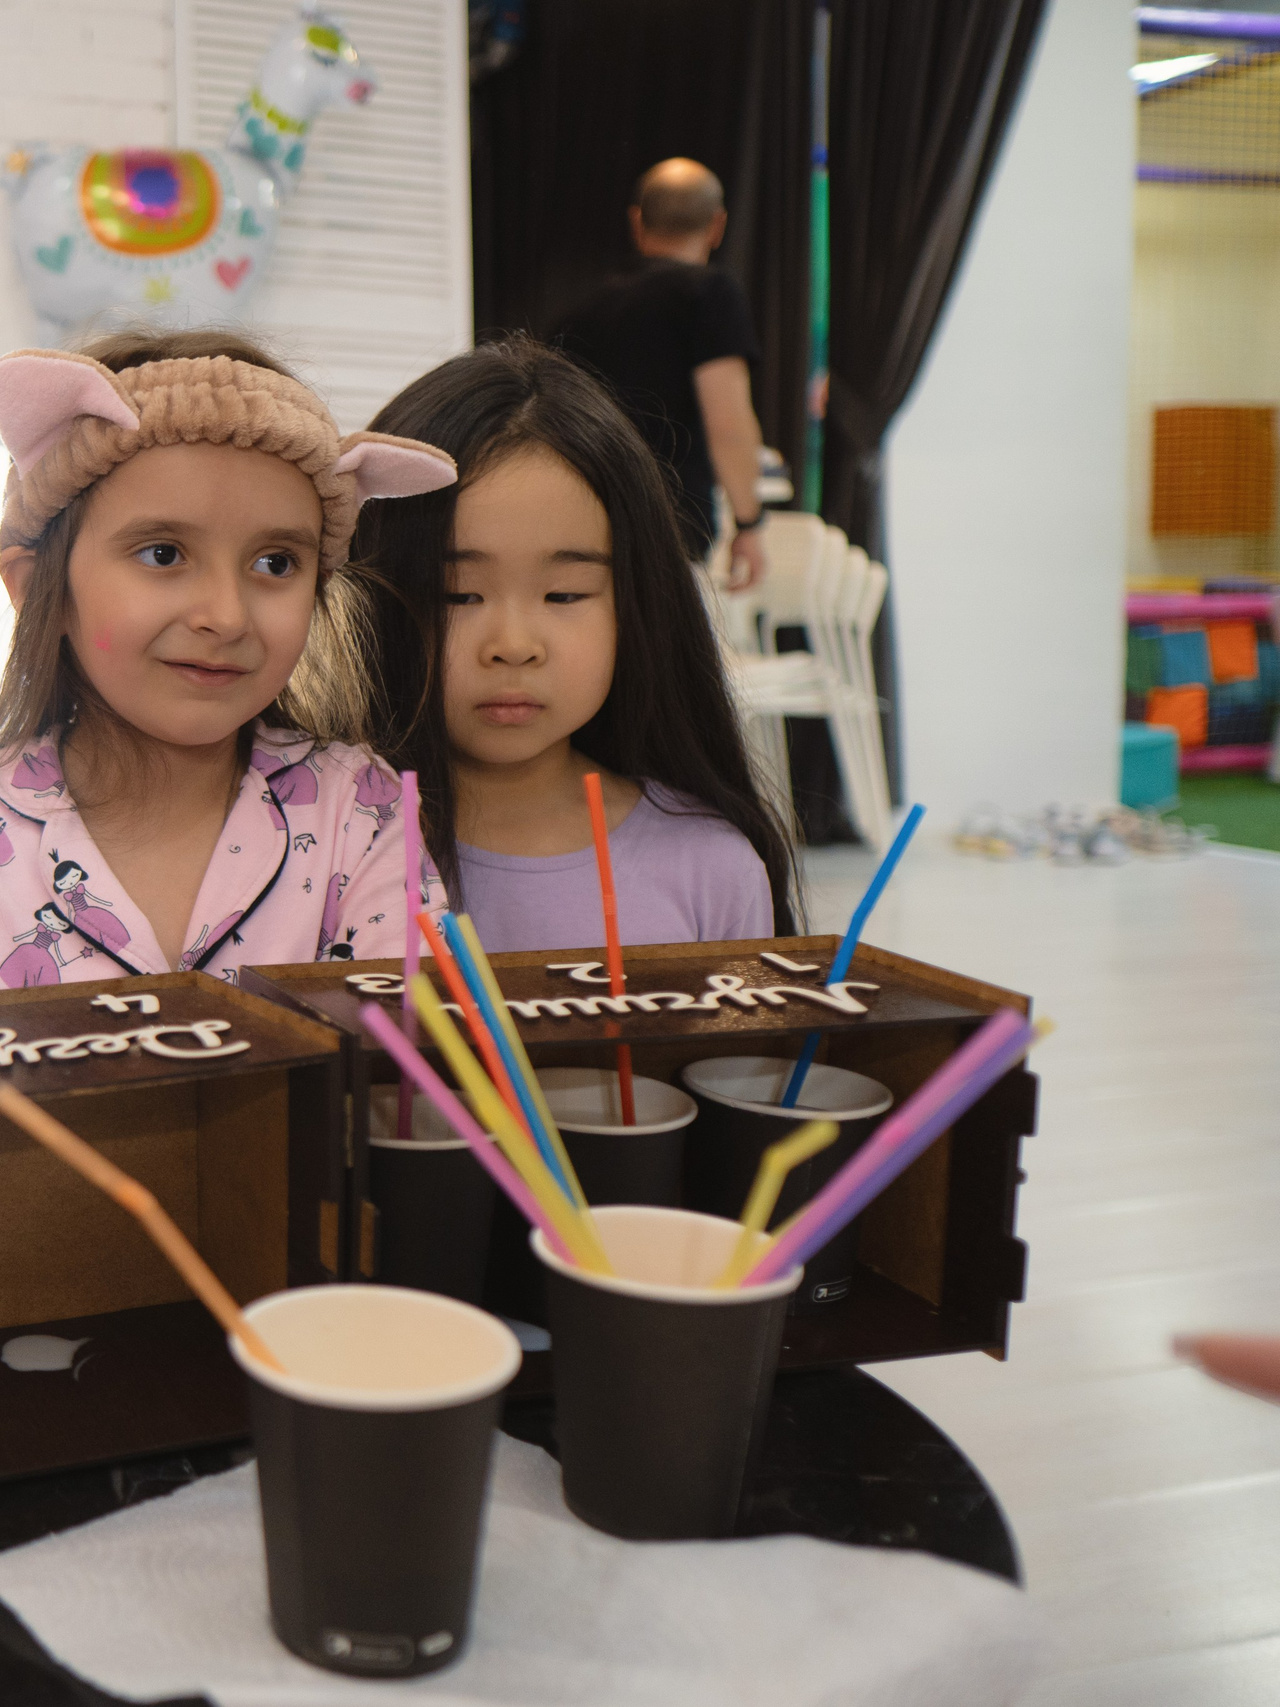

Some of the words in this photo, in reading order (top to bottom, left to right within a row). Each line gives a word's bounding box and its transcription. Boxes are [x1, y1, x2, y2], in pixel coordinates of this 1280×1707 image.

[344, 972, 406, 994] 3
[546, 960, 628, 984] 2
[90, 993, 161, 1015] 4
[438, 973, 881, 1018] Лучши
